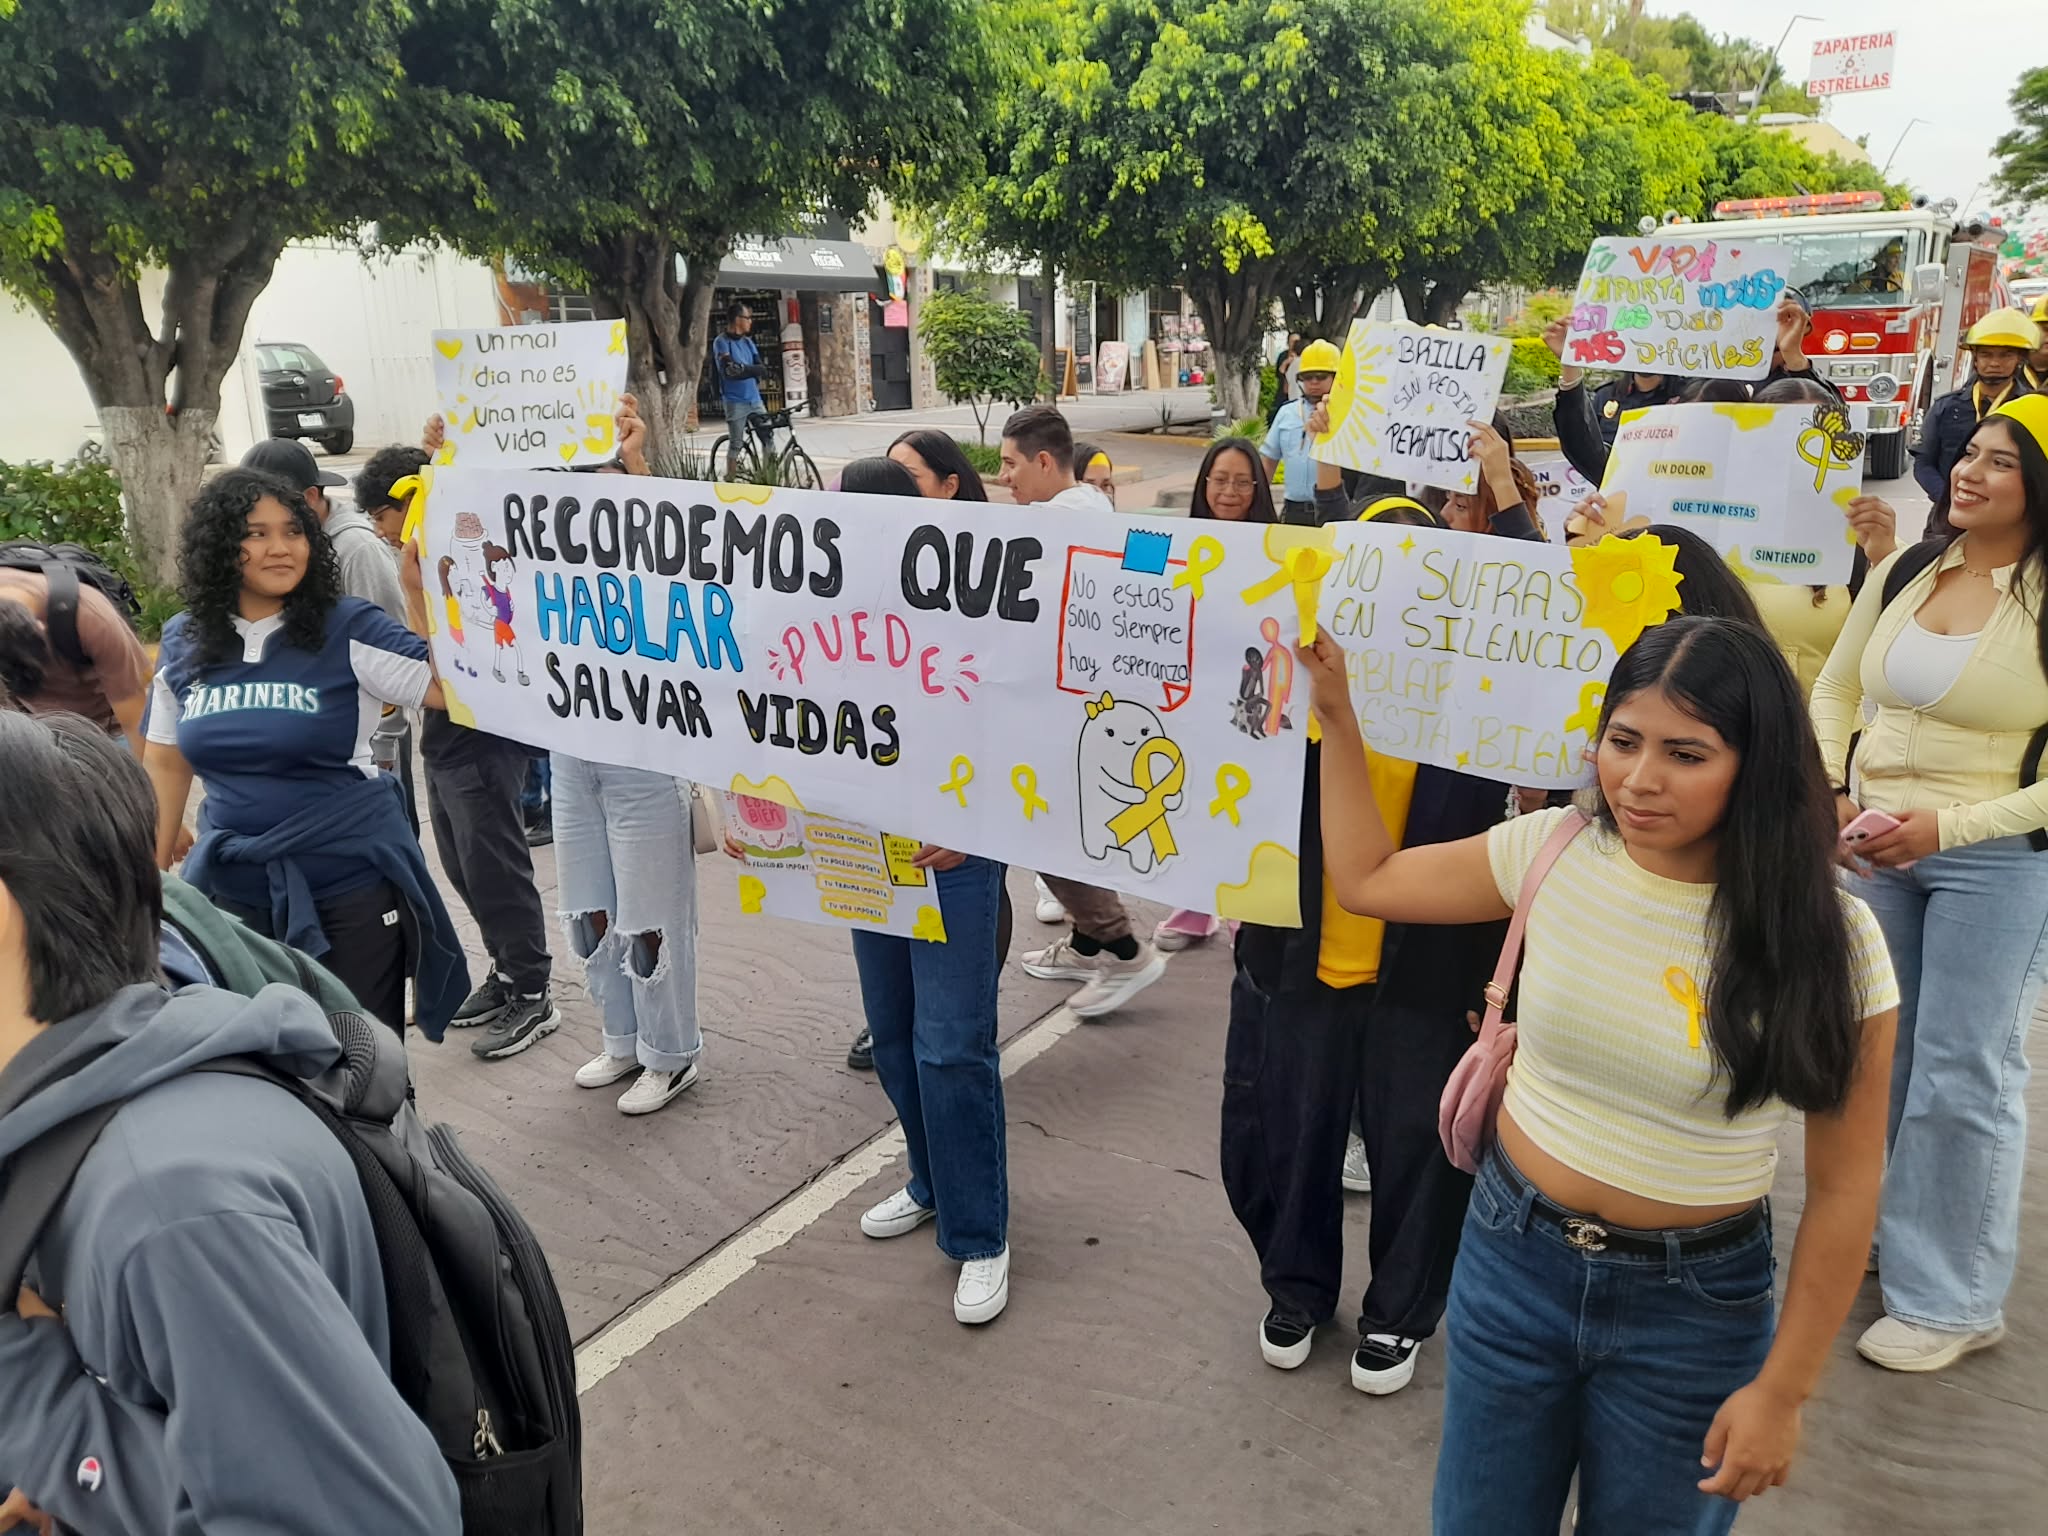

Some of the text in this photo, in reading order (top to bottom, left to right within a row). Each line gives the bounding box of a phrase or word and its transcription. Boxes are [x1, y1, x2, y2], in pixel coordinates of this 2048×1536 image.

[1813, 32, 1894, 56] ZAPATERIA
[1809, 72, 1890, 94] ESTRELLAS
[510, 331, 556, 350] mal
[1398, 336, 1486, 372] BRILLA
[475, 363, 576, 387] dia no es
[1394, 371, 1478, 421] SIN PEDIR
[522, 400, 574, 421] mala
[1621, 428, 1673, 442] NO SE JUZGA
[1654, 463, 1706, 476] UN DOLOR
[1570, 487, 1586, 496] DIF
[1672, 501, 1692, 513] QUE
[1711, 503, 1726, 515] NO
[1727, 504, 1756, 518] ESTAS
[502, 492, 1042, 623] RECORDEMOS QUE
[1754, 549, 1816, 564] SINTIENDO
[1072, 571, 1174, 612] No estas
[1331, 543, 1583, 623] NO SUFRAS
[535, 570, 946, 698] HABLAR PUEDE
[1332, 597, 1602, 672] EN SILENCIO
[1069, 642, 1189, 683] hay esperanza
[179, 680, 320, 724] MARINERS
[545, 651, 900, 767] SALVAR VIDAS
[1472, 716, 1585, 778] BIEN
[847, 836, 873, 847] IMPORTA
[855, 863, 881, 874] IMPORTA
[861, 886, 887, 897] IMPORTA
[854, 905, 881, 917] IMPORTA
